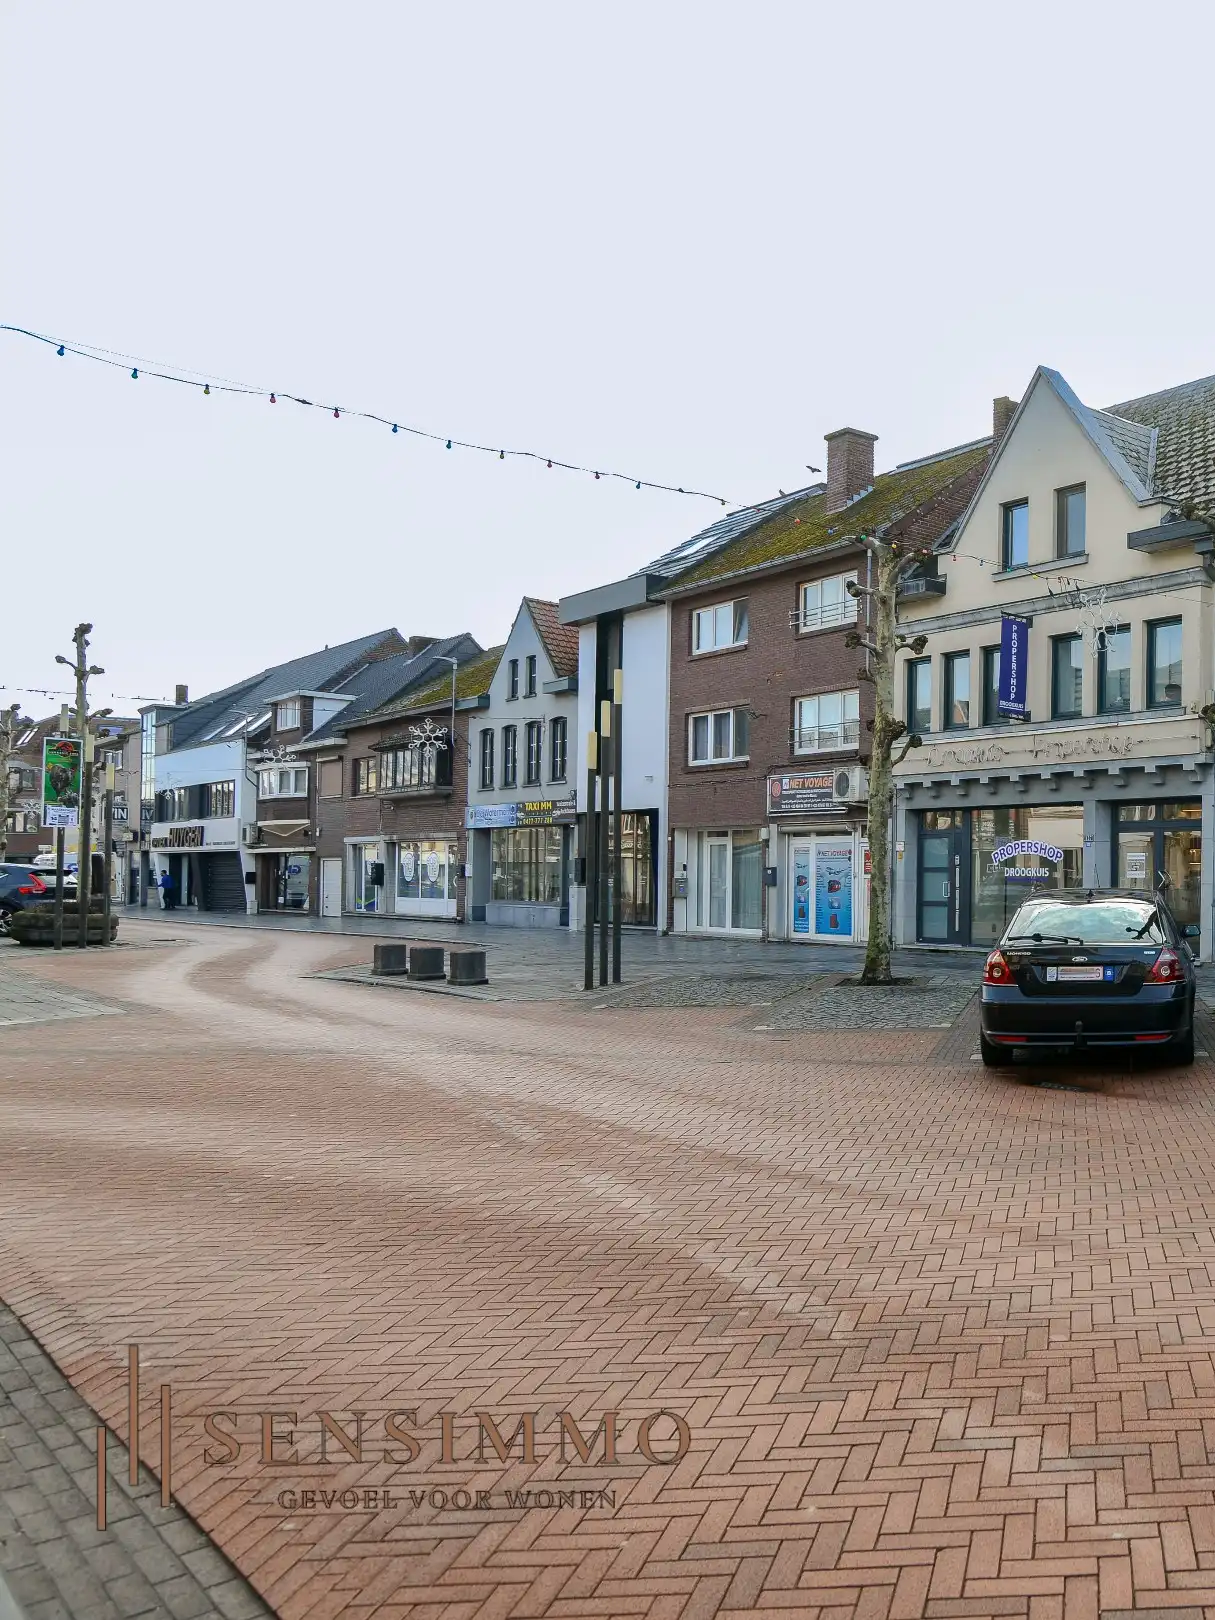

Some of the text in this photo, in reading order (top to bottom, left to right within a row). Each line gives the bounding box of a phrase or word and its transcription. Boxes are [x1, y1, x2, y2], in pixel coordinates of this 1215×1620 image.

[1010, 624, 1018, 701] PROPERSHOP
[790, 777, 833, 789] NET VOYAGE
[524, 801, 540, 811] TAXI
[168, 826, 203, 847] HUYGEN
[992, 840, 1064, 865] PROPERSHOP
[1004, 867, 1050, 877] DROOGKUIS
